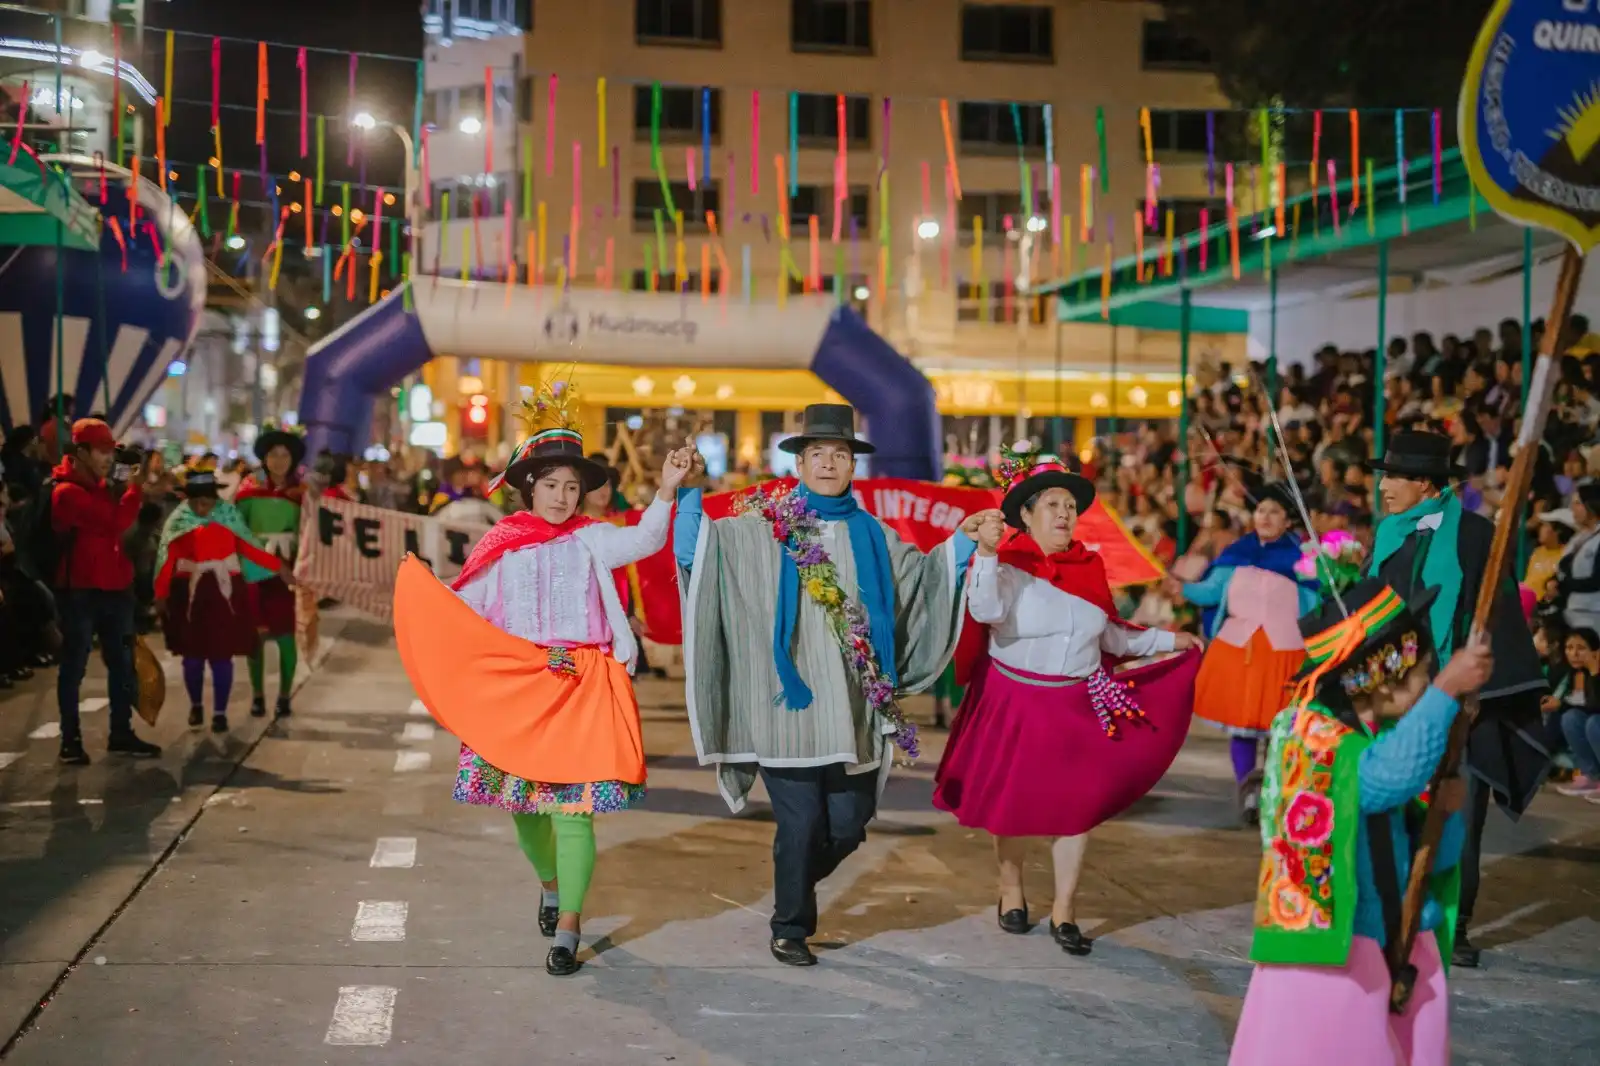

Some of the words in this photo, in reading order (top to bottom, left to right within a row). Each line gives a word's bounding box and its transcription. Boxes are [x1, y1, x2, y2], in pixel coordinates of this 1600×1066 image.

[1533, 20, 1600, 52] QUIR
[874, 488, 965, 531] INTEGR
[319, 506, 470, 565] FELI
